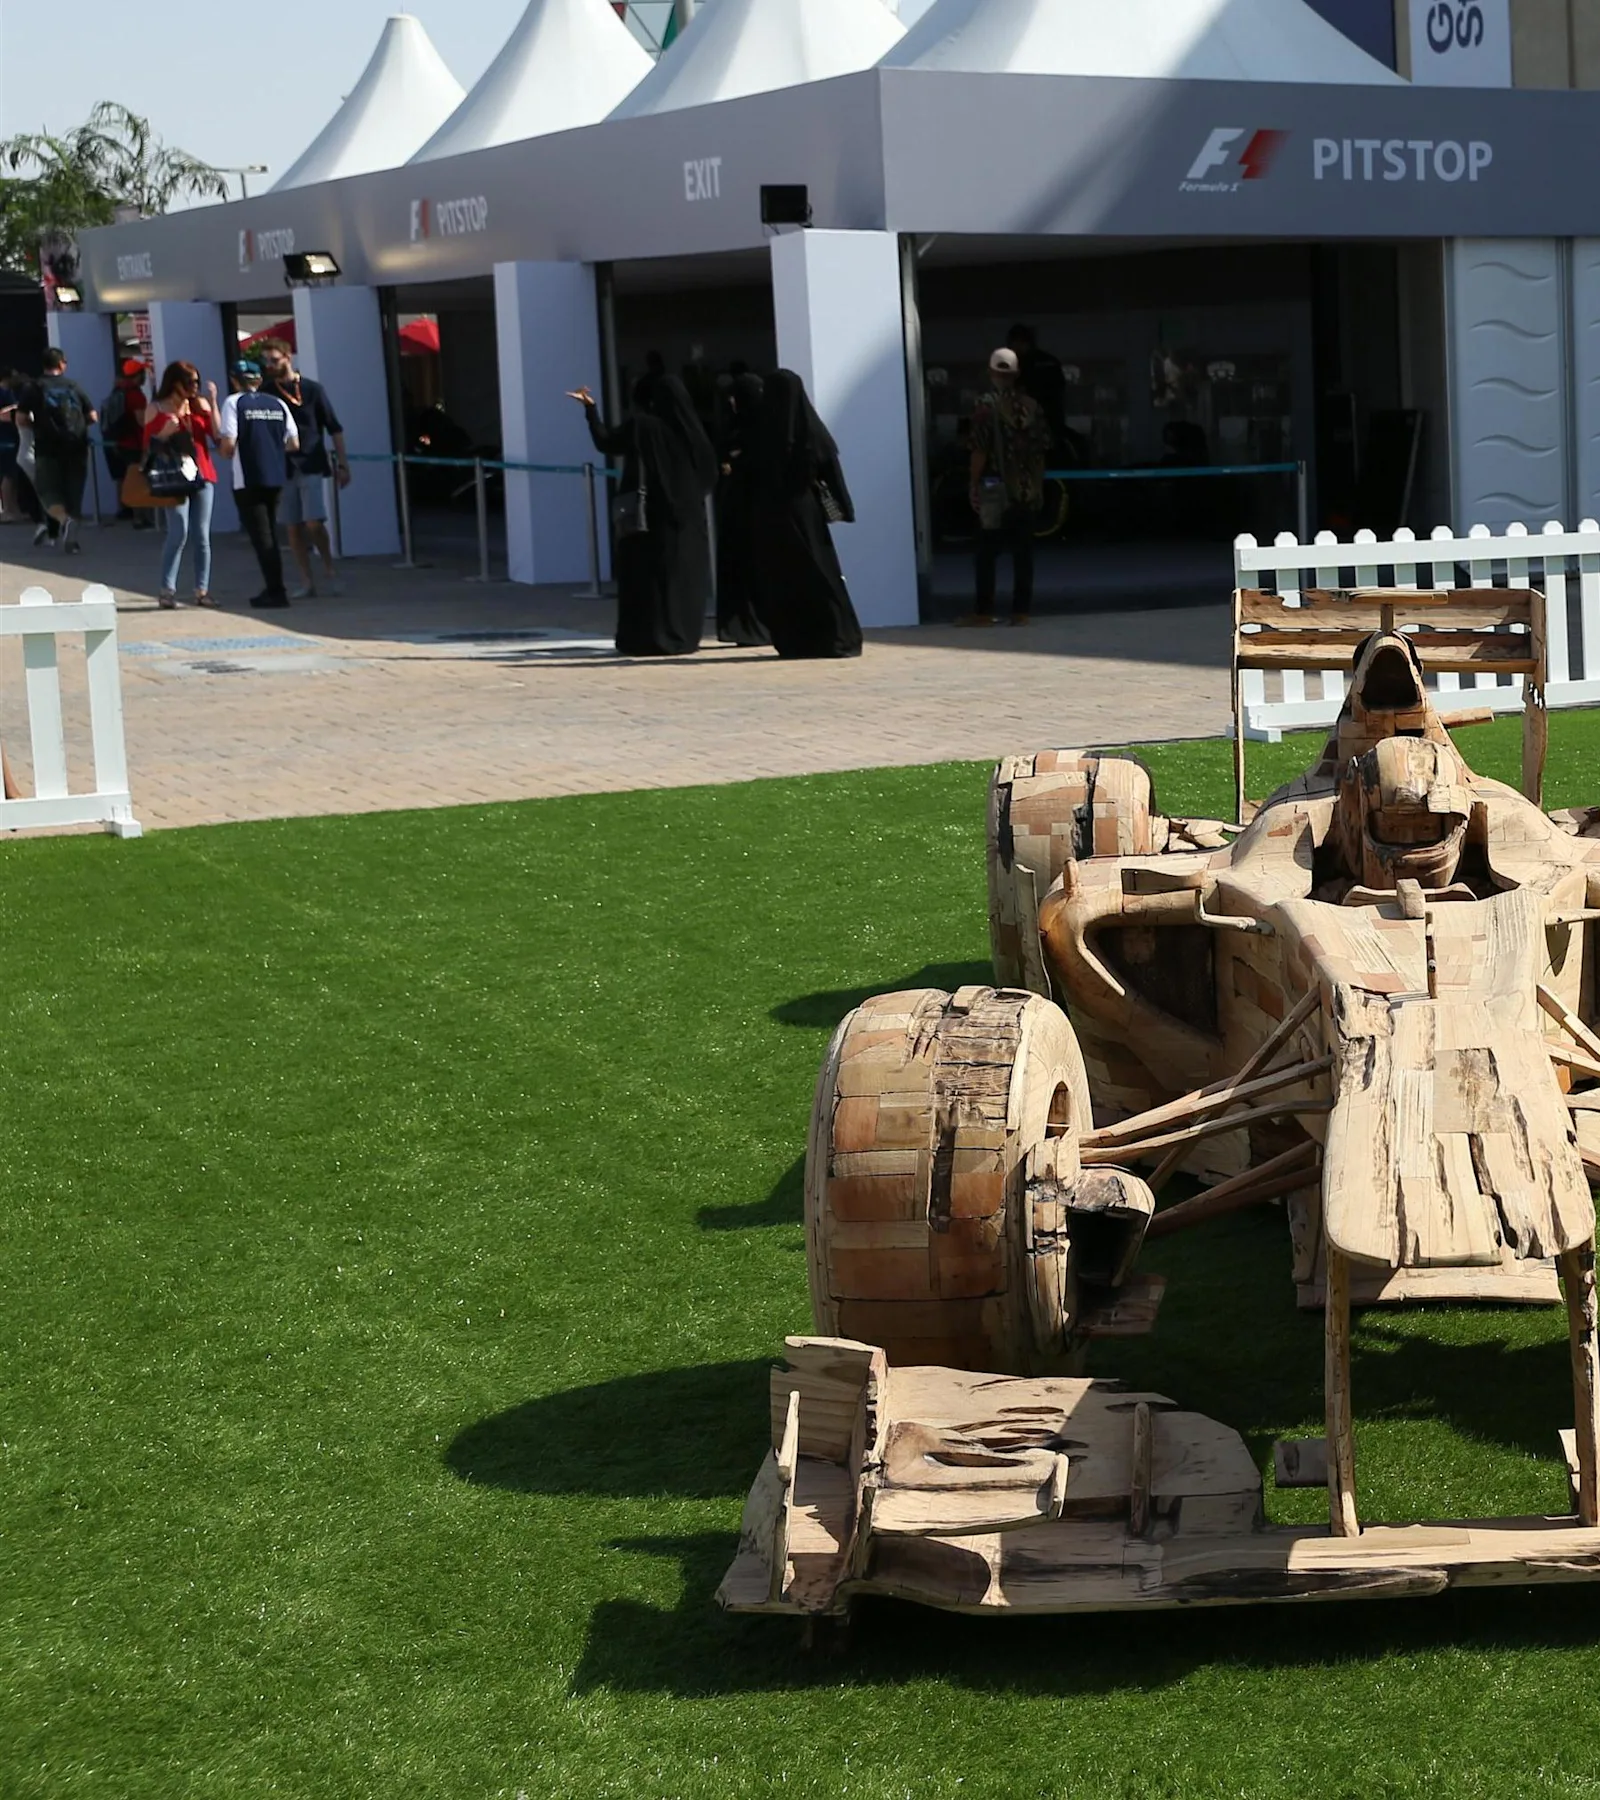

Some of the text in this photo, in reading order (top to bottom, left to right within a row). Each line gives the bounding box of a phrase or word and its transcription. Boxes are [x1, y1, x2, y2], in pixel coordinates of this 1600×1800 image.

[1427, 0, 1454, 54] G
[1456, 0, 1484, 48] S
[683, 156, 722, 201] EXIT
[1313, 138, 1493, 182] PITSTOP
[1179, 181, 1229, 192] Formula
[436, 195, 487, 237] PITSTOP
[257, 228, 295, 261] PITSTOP
